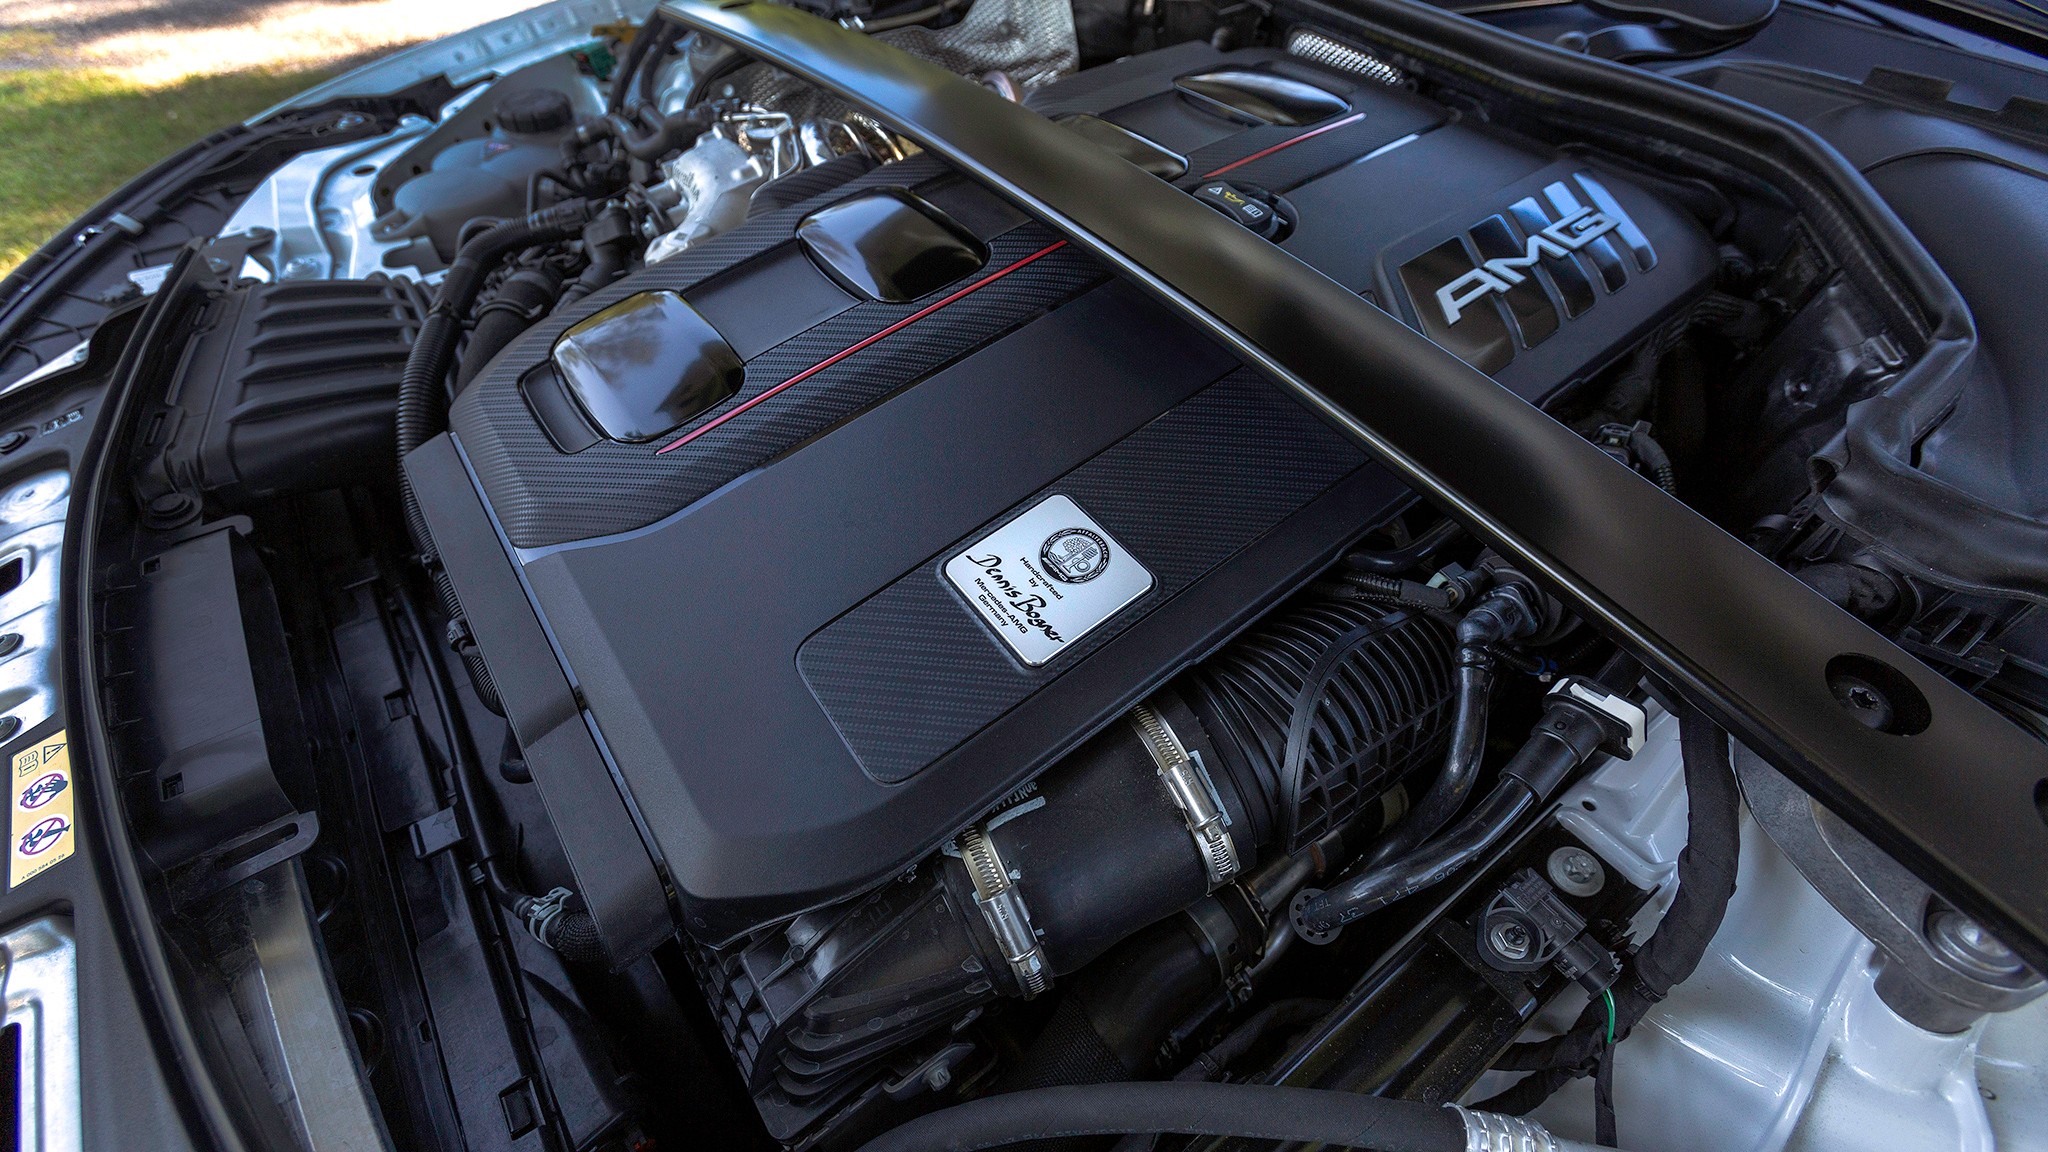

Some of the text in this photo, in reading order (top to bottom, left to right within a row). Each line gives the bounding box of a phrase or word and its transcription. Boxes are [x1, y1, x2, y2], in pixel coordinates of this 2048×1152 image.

[1435, 205, 1621, 325] AMG
[965, 553, 1065, 643] Dennis Bogner
[1020, 557, 1064, 600] Handcrafted
[1028, 577, 1039, 588] by
[974, 577, 1029, 634] Mercedes-AMG
[978, 594, 1009, 627] Germany
